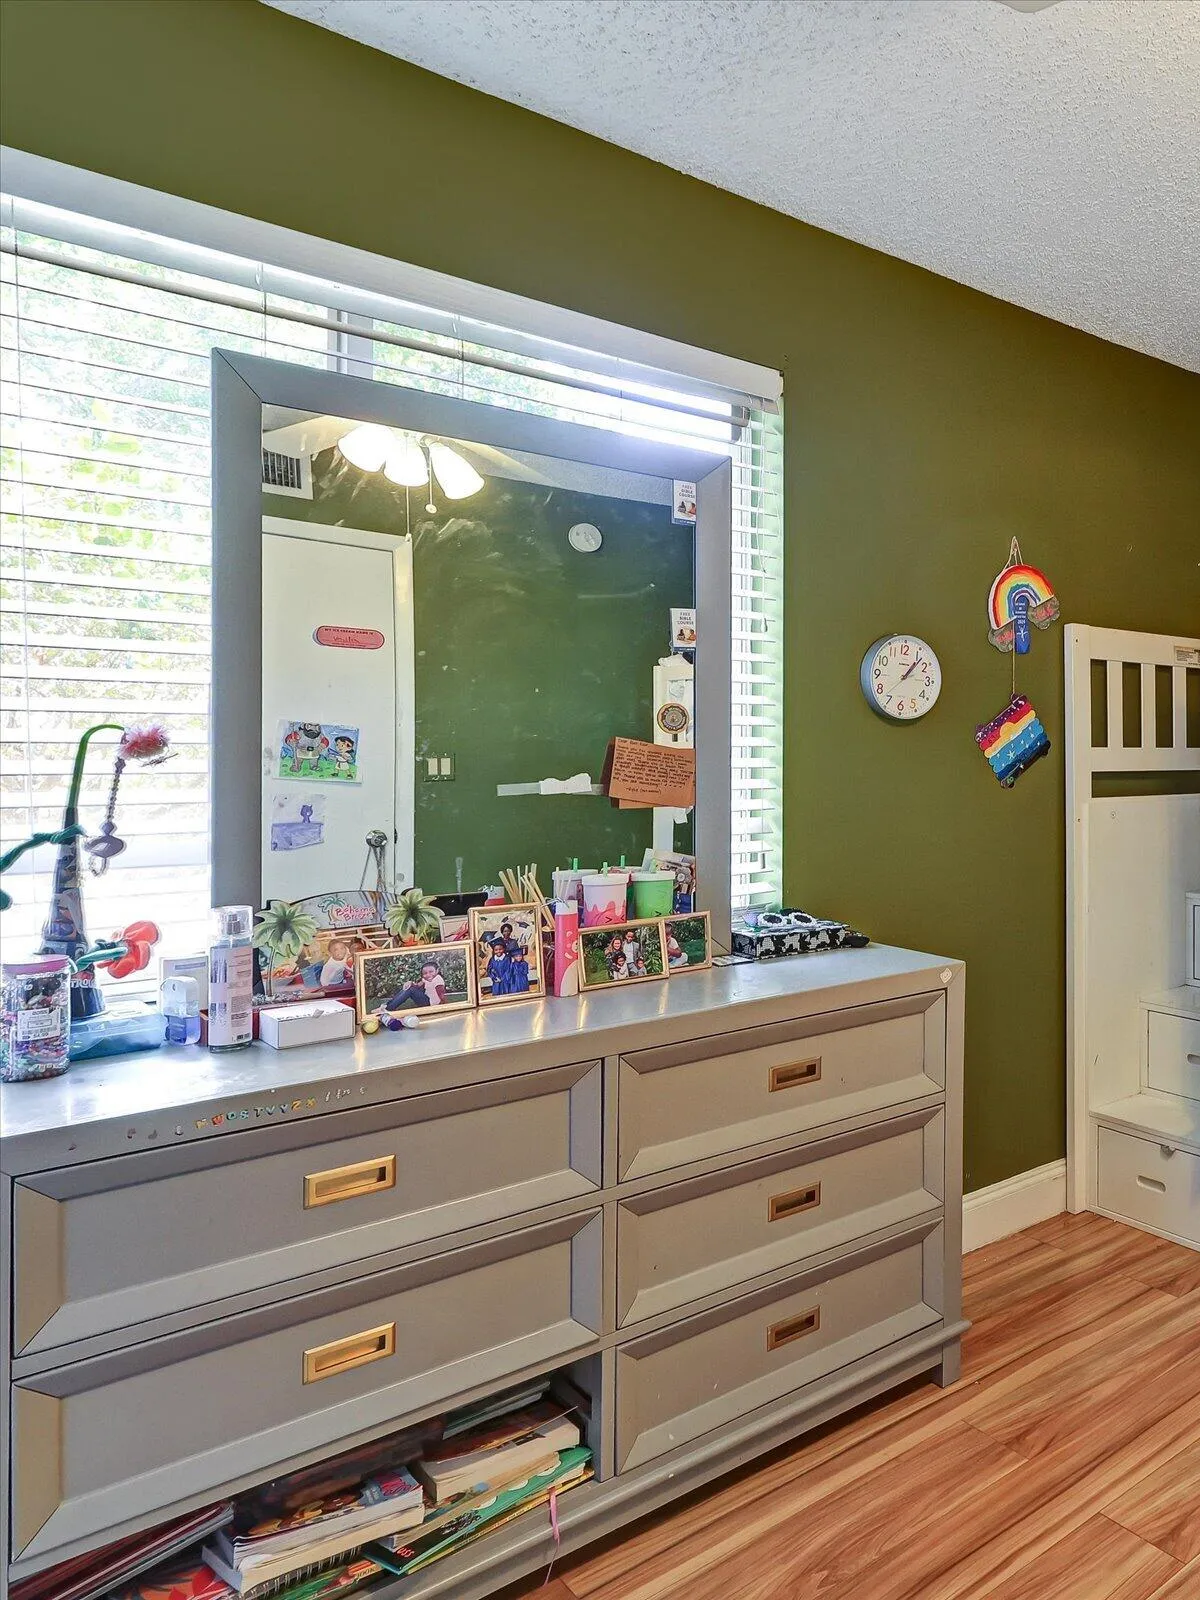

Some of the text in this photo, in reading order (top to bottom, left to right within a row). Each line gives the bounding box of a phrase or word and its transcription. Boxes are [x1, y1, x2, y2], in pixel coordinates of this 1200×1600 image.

[889, 647, 897, 657] 11
[901, 644, 909, 656] 12
[878, 655, 888, 666] 10
[921, 662, 928, 673] 2
[874, 669, 881, 679] 9
[925, 676, 931, 687] 3
[876, 683, 884, 694] 8
[886, 695, 893, 705] 7
[919, 690, 925, 699] 4
[897, 700, 904, 711] 6
[910, 699, 916, 709] 5
[335, 905, 376, 916] Bahama
